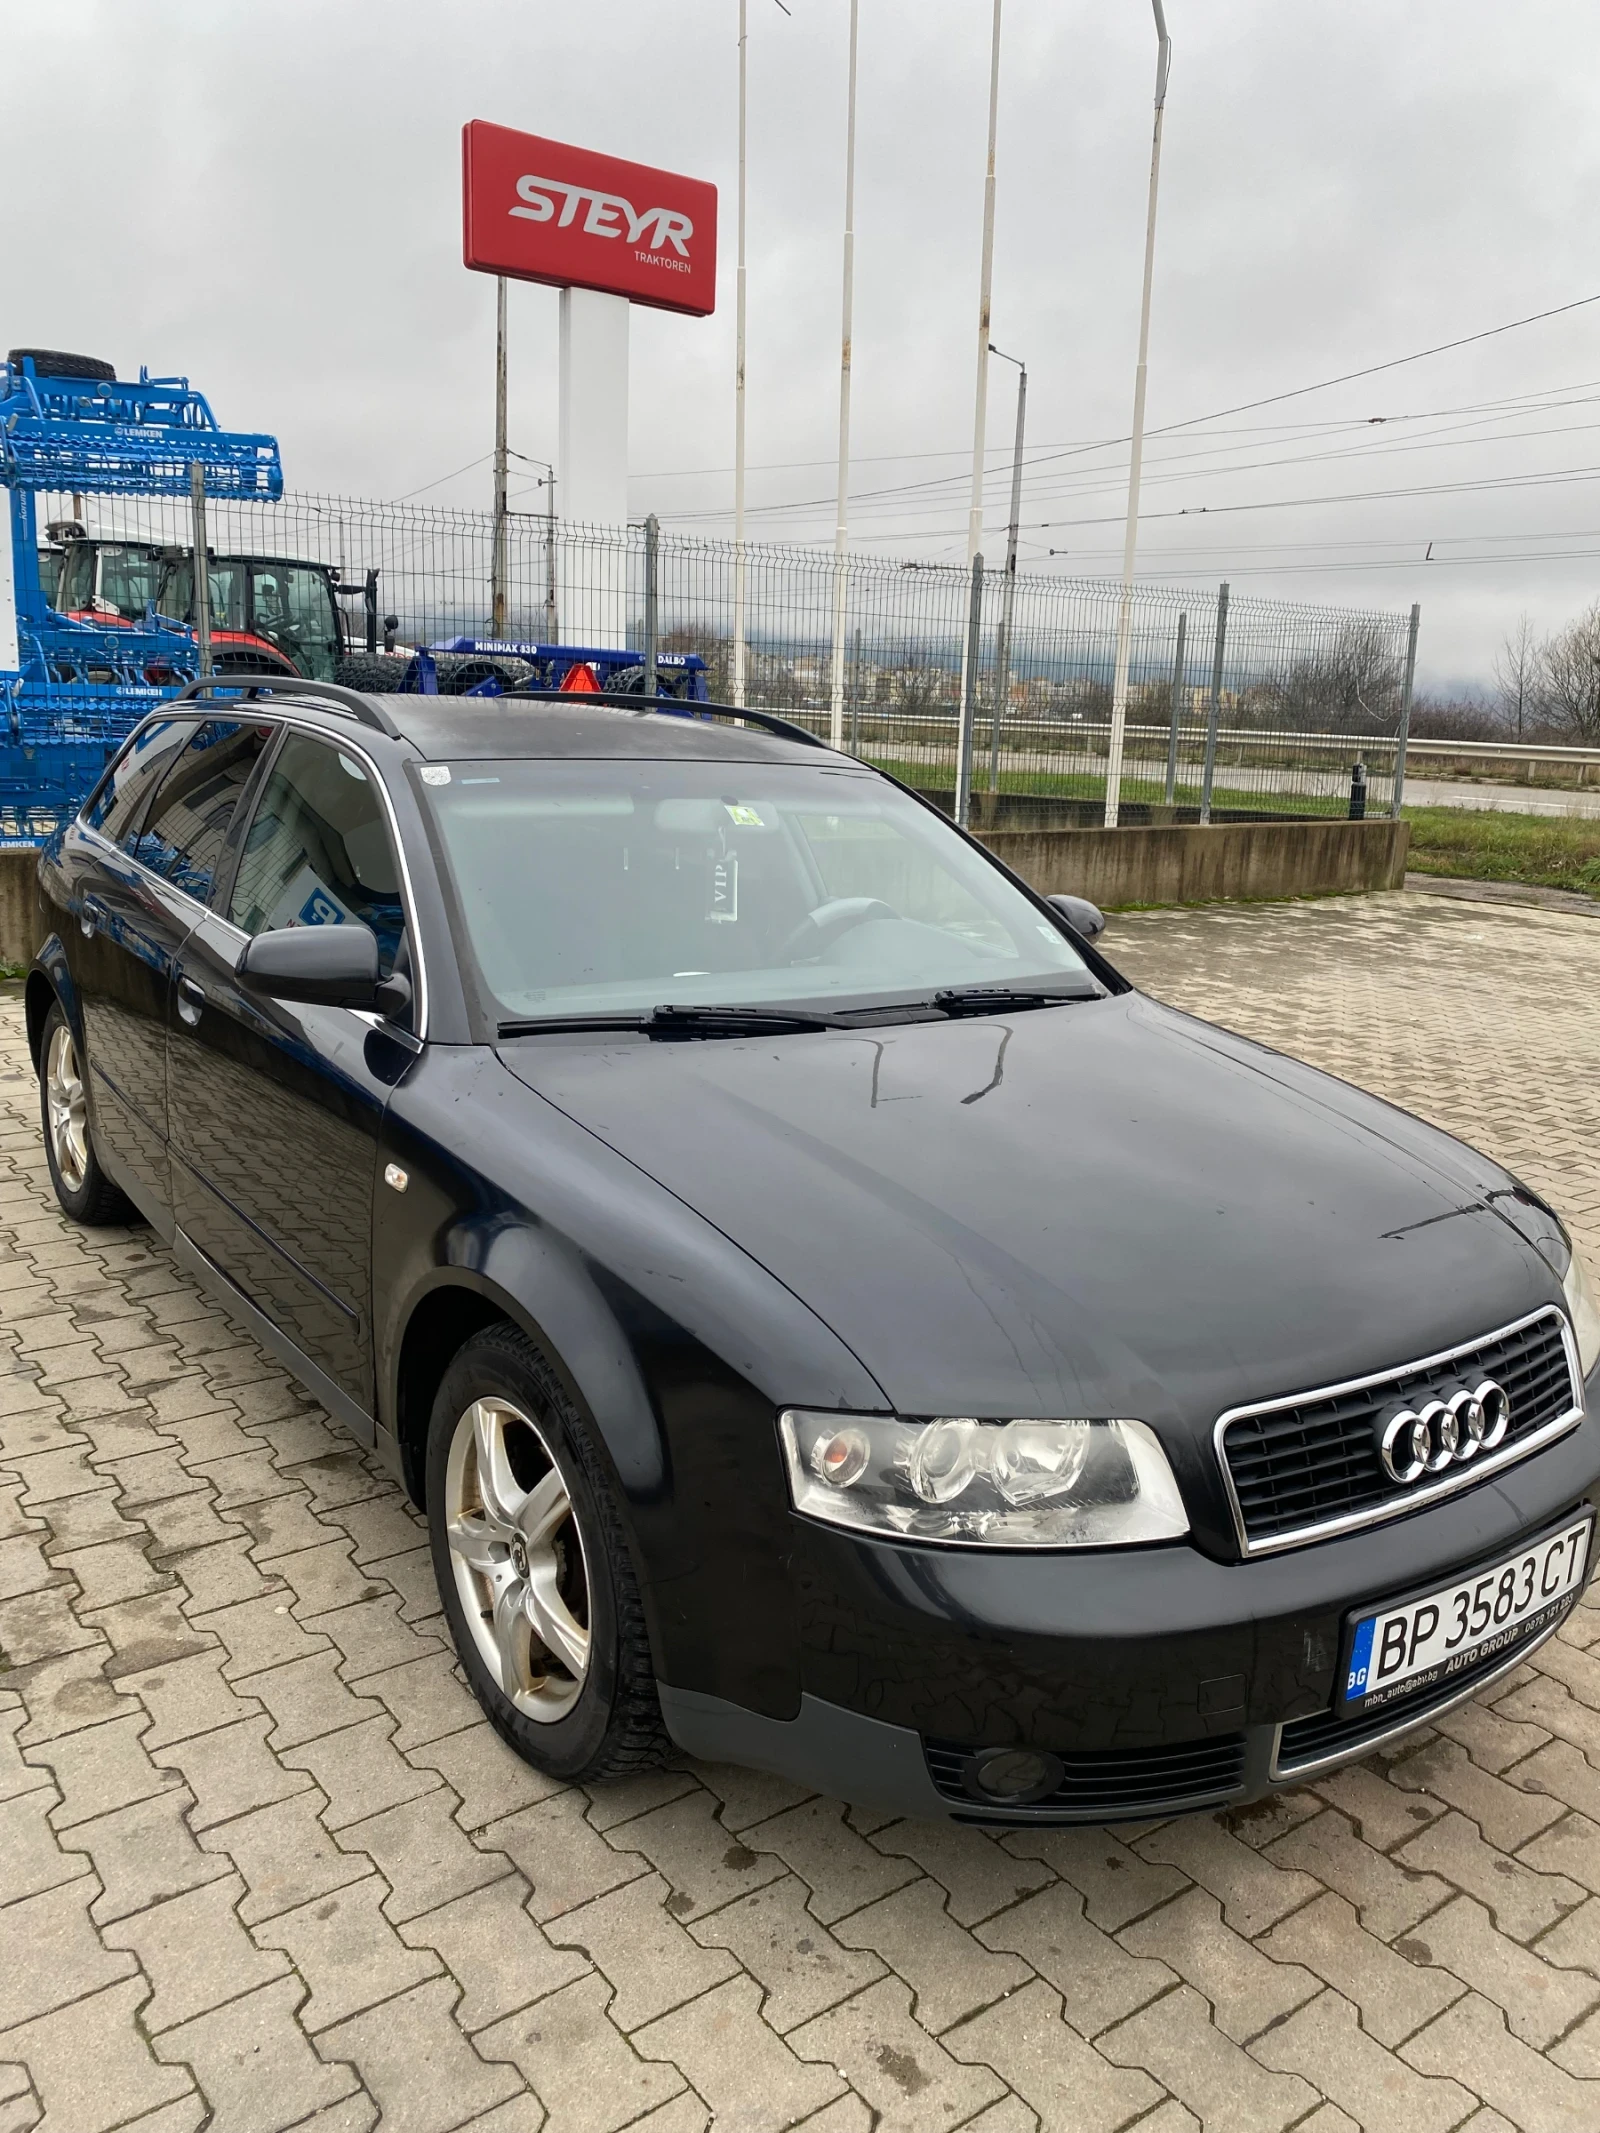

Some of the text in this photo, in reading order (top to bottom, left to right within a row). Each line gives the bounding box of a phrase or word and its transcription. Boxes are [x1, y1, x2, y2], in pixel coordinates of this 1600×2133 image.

[508, 174, 694, 257] STEYR
[634, 250, 691, 274] TRAKTOREN
[124, 427, 163, 439] LEMKEN
[475, 641, 519, 654] MINIMAX
[658, 655, 686, 666] DALBO
[125, 687, 163, 697] LEMKEN
[0, 840, 36, 848] EMKEN
[714, 864, 727, 903] VIP
[1376, 1525, 1587, 1680] BP 3583 CT
[1347, 1667, 1367, 1690] BG
[1364, 1670, 1438, 1708] mbn_auto@abv.bg
[1445, 1648, 1478, 1675] AUTO
[1480, 1627, 1519, 1657] GROUP
